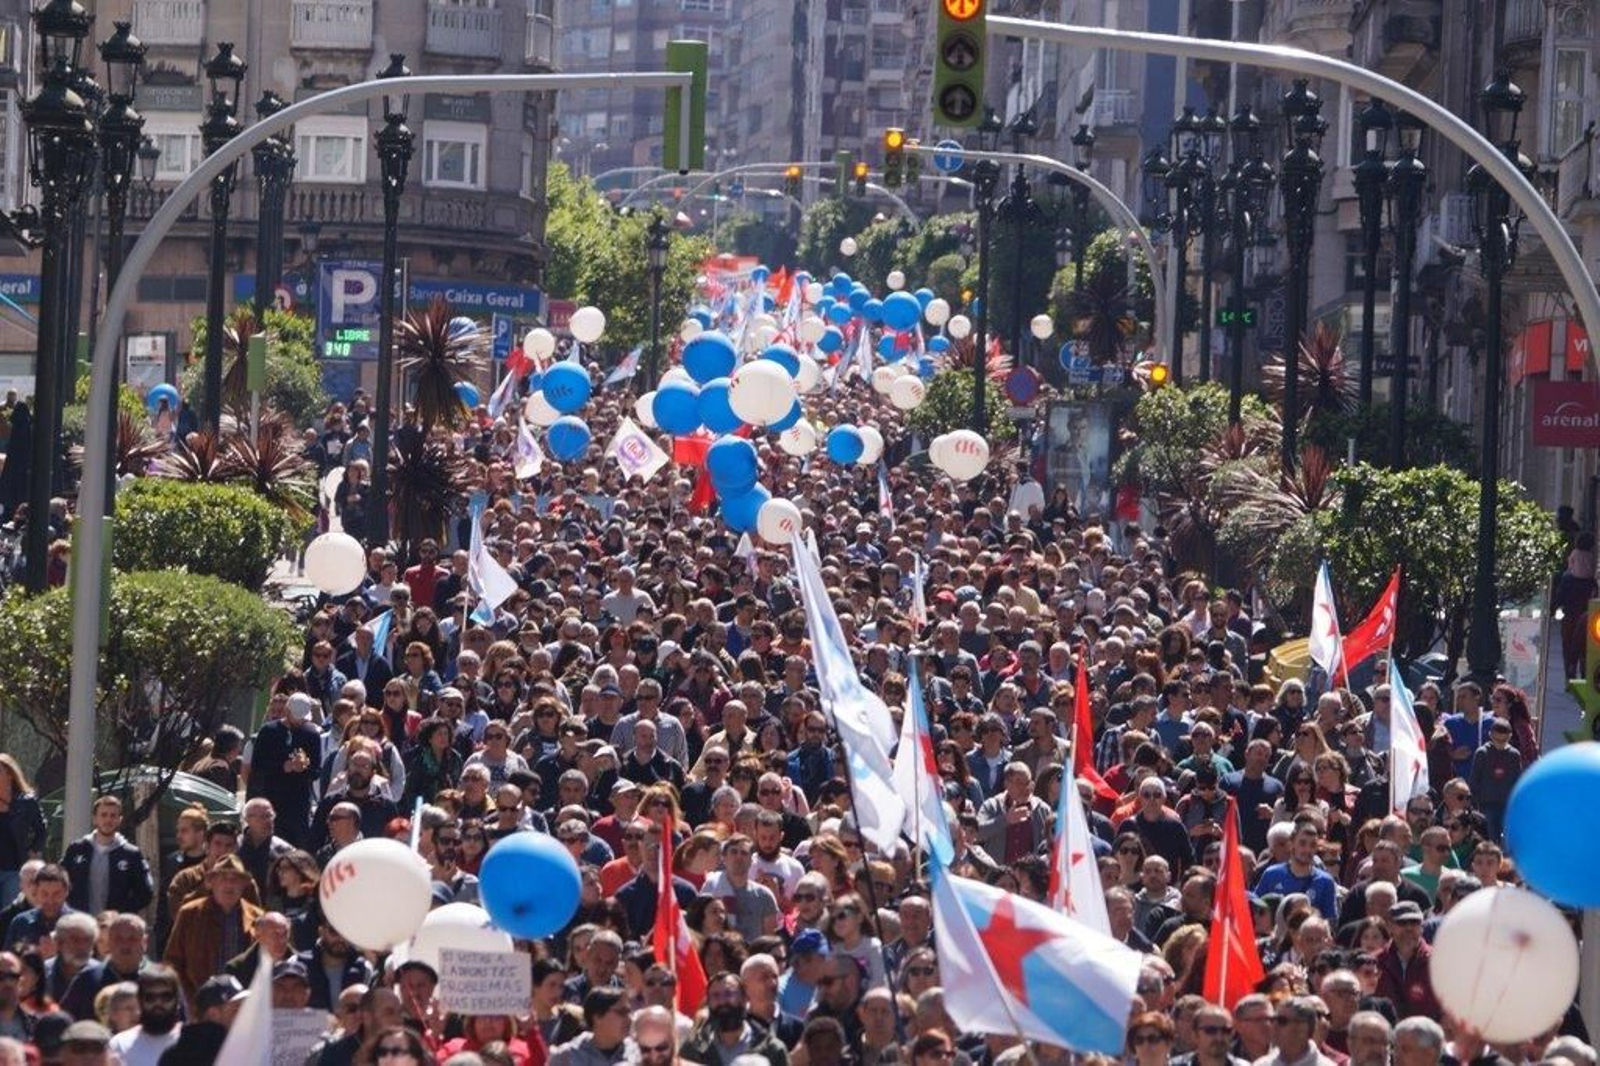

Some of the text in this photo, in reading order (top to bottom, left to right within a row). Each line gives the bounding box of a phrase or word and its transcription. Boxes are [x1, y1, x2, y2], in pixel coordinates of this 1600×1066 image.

[0, 279, 31, 294] eral
[331, 269, 377, 323] P
[445, 290, 482, 304] Caixa
[486, 292, 524, 308] Geral
[336, 329, 370, 341] LIBRE
[1541, 412, 1600, 426] arenal
